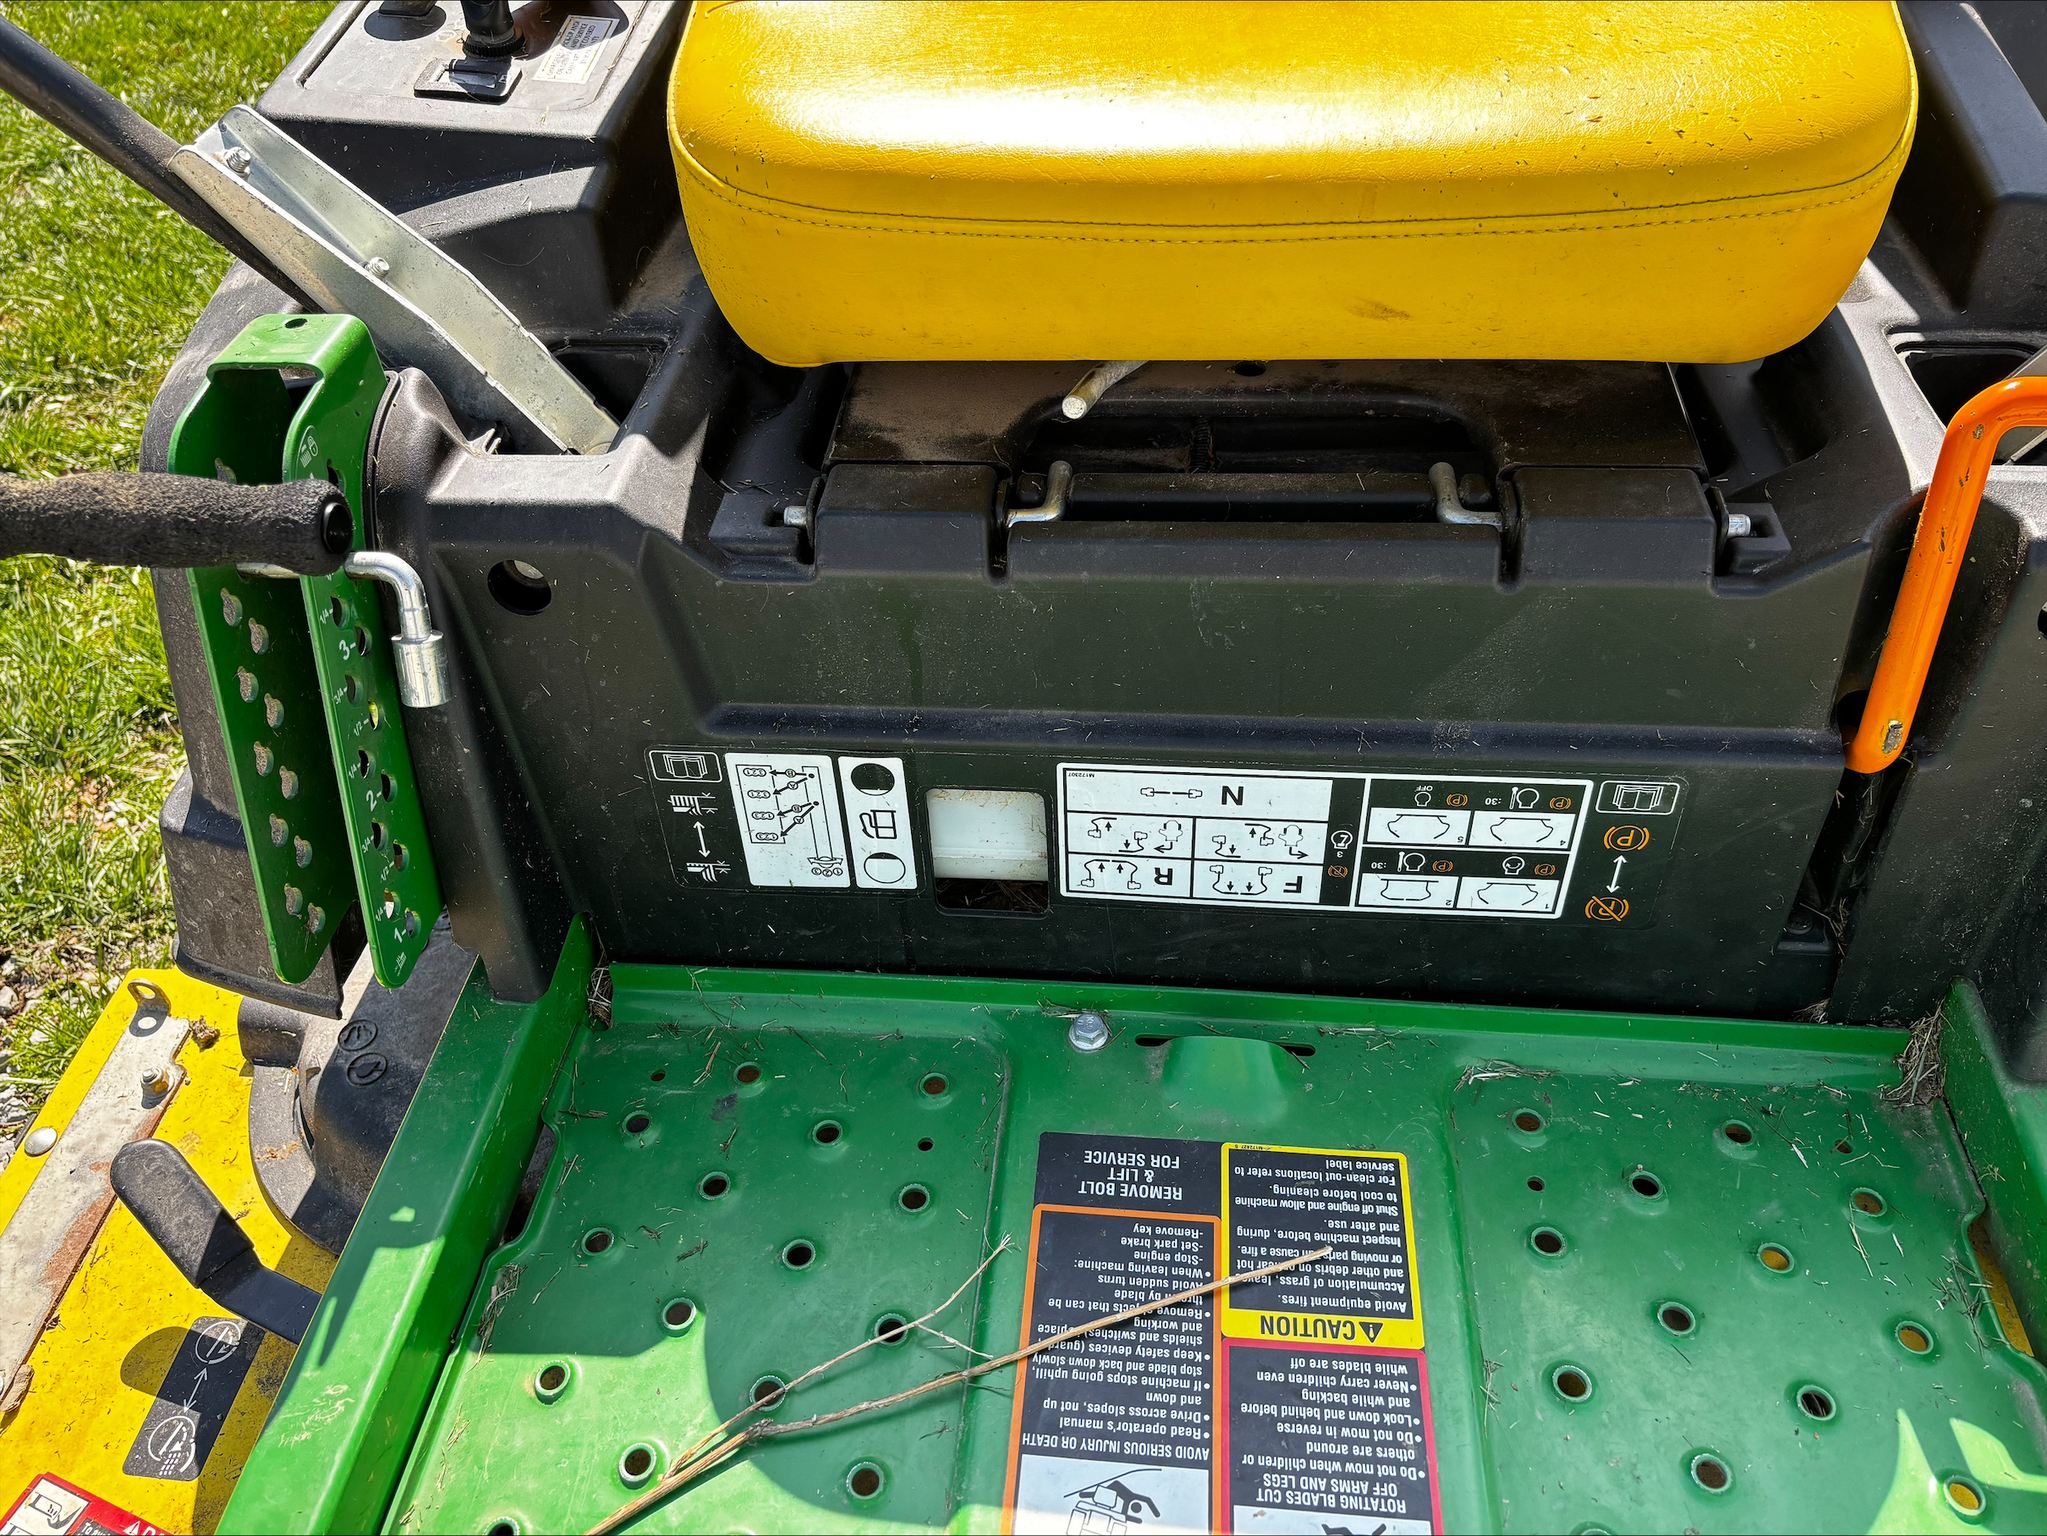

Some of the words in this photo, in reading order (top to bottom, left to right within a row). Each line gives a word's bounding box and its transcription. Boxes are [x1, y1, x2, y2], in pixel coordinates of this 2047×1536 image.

[339, 639, 350, 661] 3
[1415, 784, 1433, 792] OFF
[366, 790, 377, 812] 2
[1221, 785, 1244, 806] N
[1153, 867, 1173, 886] R
[1283, 875, 1303, 894] F
[393, 927, 404, 944] 1
[1083, 1150, 1146, 1167] SERVICE
[1150, 1154, 1180, 1170] FOR
[1325, 1160, 1353, 1171] label
[1234, 1166, 1245, 1177] to
[1246, 1167, 1273, 1178] refer
[1355, 1161, 1395, 1172] service
[1107, 1167, 1139, 1182] LIFT
[1144, 1169, 1155, 1183] &
[1275, 1169, 1323, 1182] locations
[1325, 1172, 1376, 1185] clean-out
[1377, 1175, 1396, 1187] For
[1078, 1181, 1116, 1196] BOLT
[1119, 1183, 1183, 1201] REMOVE
[1269, 1184, 1320, 1199] cleaning.
[1322, 1189, 1358, 1201] before
[1235, 1196, 1278, 1208] machine
[1360, 1191, 1384, 1202] cool
[1386, 1192, 1398, 1203] to
[1279, 1199, 1306, 1211] allow
[1307, 1201, 1326, 1212] and
[1327, 1201, 1361, 1214] engine
[1361, 1204, 1375, 1215] off
[1375, 1205, 1399, 1217] Shut
[1133, 1223, 1152, 1237] key
[1323, 1219, 1348, 1229] use.
[1350, 1221, 1377, 1233] after
[1379, 1223, 1401, 1234] and
[1237, 1225, 1271, 1240] during
[1273, 1229, 1312, 1243] before,
[1314, 1232, 1360, 1245] machine
[1120, 1237, 1151, 1249] brake
[1154, 1239, 1178, 1250] park
[1361, 1234, 1402, 1248] Inspect
[1133, 1250, 1171, 1263] engine
[1237, 1246, 1259, 1258] fire.
[1260, 1247, 1268, 1256] a
[1269, 1247, 1302, 1261] cause
[1350, 1250, 1390, 1264] moving
[1074, 1259, 1125, 1272] machine:
[1236, 1259, 1255, 1271] hot
[1391, 1254, 1403, 1264] or
[1128, 1261, 1168, 1277] leaving
[1171, 1267, 1204, 1280] When
[1298, 1262, 1313, 1273] on
[1314, 1264, 1350, 1277] debris
[1351, 1266, 1381, 1279] other
[1383, 1268, 1405, 1280] and
[1097, 1274, 1126, 1287] turns
[1129, 1277, 1170, 1289] sudden
[1171, 1279, 1204, 1293] Avoid
[1275, 1275, 1311, 1287] grass,
[1313, 1278, 1325, 1290] of
[1327, 1279, 1406, 1295] Accumulation
[1114, 1289, 1146, 1302] blade
[1148, 1290, 1162, 1304] by
[1277, 1294, 1308, 1308] fires.
[1048, 1298, 1062, 1310] be
[1065, 1299, 1085, 1310] can
[1088, 1301, 1110, 1313] that
[1310, 1296, 1372, 1310] equipment
[1374, 1300, 1407, 1314] Avoid
[1156, 1305, 1204, 1320] Remove
[1134, 1316, 1179, 1331] working
[1181, 1322, 1203, 1333] and
[1260, 1314, 1357, 1342] CAUTION
[1139, 1332, 1160, 1344] and
[1162, 1334, 1203, 1347] shields
[1036, 1337, 1086, 1354] (guard,
[1088, 1343, 1133, 1358] devices
[1135, 1344, 1171, 1360] safety
[1031, 1351, 1067, 1368] slowly
[1173, 1347, 1203, 1363] Keep
[1068, 1357, 1097, 1370] down
[1098, 1359, 1123, 1373] back
[1125, 1361, 1146, 1373] and
[1148, 1363, 1178, 1377] blade
[1180, 1363, 1203, 1378] stop
[1290, 1357, 1306, 1370] off
[1309, 1358, 1329, 1370] are
[1331, 1360, 1372, 1375] blades
[1374, 1363, 1409, 1377] while
[1032, 1366, 1069, 1381] uphill,
[1071, 1368, 1104, 1384] going
[1107, 1372, 1139, 1387] stops
[1256, 1371, 1285, 1383] even
[1141, 1376, 1191, 1390] machine
[1193, 1380, 1202, 1392] If
[1288, 1373, 1337, 1389] children
[1340, 1374, 1371, 1389] carry
[1373, 1379, 1410, 1394] Never
[1043, 1397, 1058, 1410] up
[1146, 1392, 1177, 1406] down
[1180, 1395, 1203, 1407] and
[1301, 1388, 1349, 1407] backing
[1351, 1394, 1386, 1409] while
[1387, 1396, 1411, 1410] and
[1060, 1401, 1080, 1413] not
[1083, 1401, 1126, 1418] slopes,
[1128, 1406, 1168, 1419] across
[1240, 1403, 1278, 1418] before
[1281, 1405, 1321, 1421] behind
[1170, 1410, 1202, 1424] Drive
[1323, 1408, 1346, 1422] and
[1348, 1410, 1381, 1426] down
[1382, 1413, 1413, 1428] Look
[1059, 1416, 1104, 1430] manual
[1107, 1420, 1168, 1435] operator's
[1276, 1422, 1323, 1436] reverse
[1170, 1426, 1202, 1441] Read
[1325, 1425, 1338, 1440] in
[1340, 1427, 1371, 1440] mow
[1373, 1429, 1394, 1443] not
[1396, 1431, 1415, 1446] Do
[1022, 1432, 1059, 1449] DEATH
[1061, 1436, 1078, 1450] OR
[1079, 1438, 1121, 1454] INJURY
[1123, 1441, 1173, 1459] SERIOUS
[1175, 1445, 1211, 1461] AVOID
[1306, 1441, 1349, 1456] around
[1352, 1445, 1373, 1457] are
[1375, 1446, 1416, 1463] others
[1241, 1454, 1255, 1466] or
[1257, 1455, 1307, 1472] children
[1309, 1459, 1343, 1475] when
[1344, 1462, 1375, 1475] mow
[1376, 1464, 1398, 1478] not
[1399, 1466, 1418, 1482] Do
[1262, 1473, 1296, 1490] LEGS
[1299, 1476, 1328, 1492] AND
[1330, 1478, 1370, 1496] ARMS
[1256, 1488, 1283, 1504] CUT
[1372, 1482, 1398, 1498] OFF
[1285, 1490, 1337, 1509] BLADES
[1339, 1494, 1407, 1515] ROTATING
